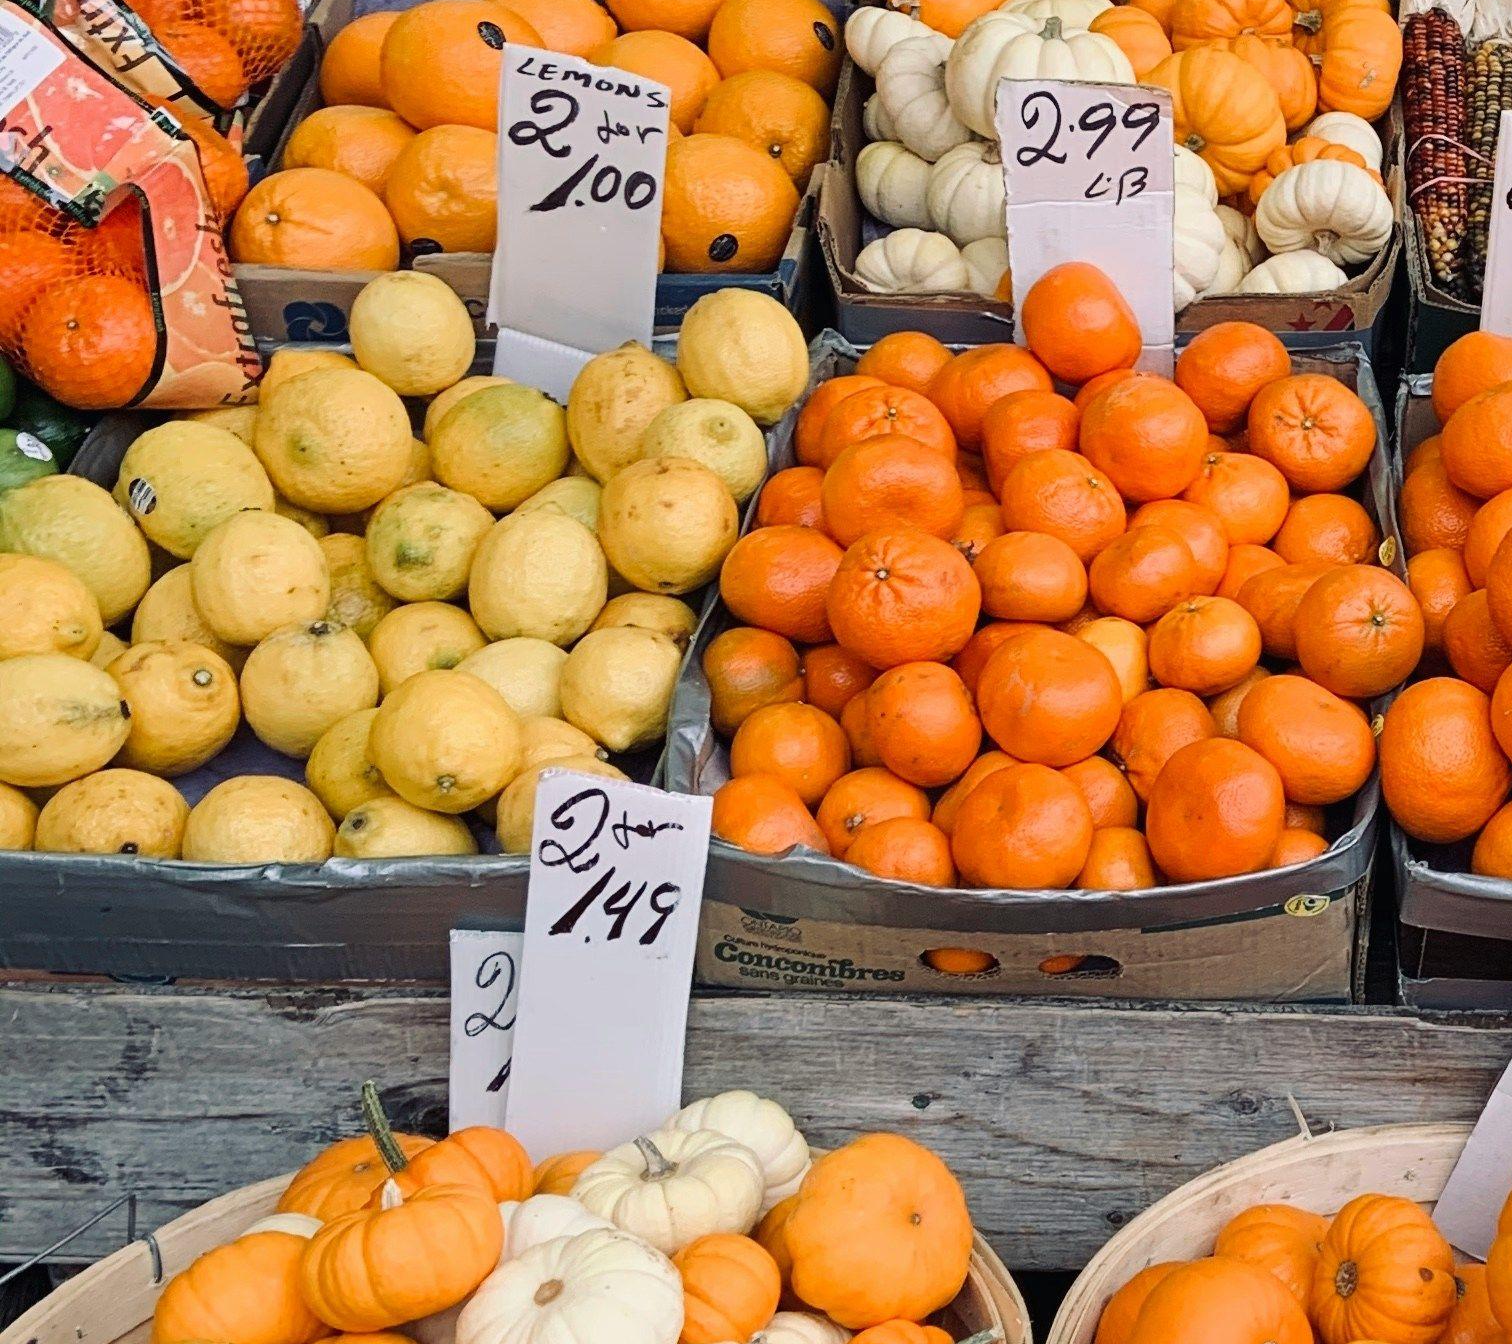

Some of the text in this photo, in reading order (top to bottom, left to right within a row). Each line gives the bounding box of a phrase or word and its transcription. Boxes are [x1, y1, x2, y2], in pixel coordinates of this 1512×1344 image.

[516, 56, 670, 108] LEMONS
[507, 88, 664, 158] 2 for
[1016, 89, 1161, 167] 2.99
[527, 153, 658, 213] 1.00
[538, 787, 611, 874] 2
[547, 865, 683, 946] 1.49
[464, 949, 518, 1038] 2
[713, 940, 906, 982] Concombres
[738, 965, 845, 989] sans graines
